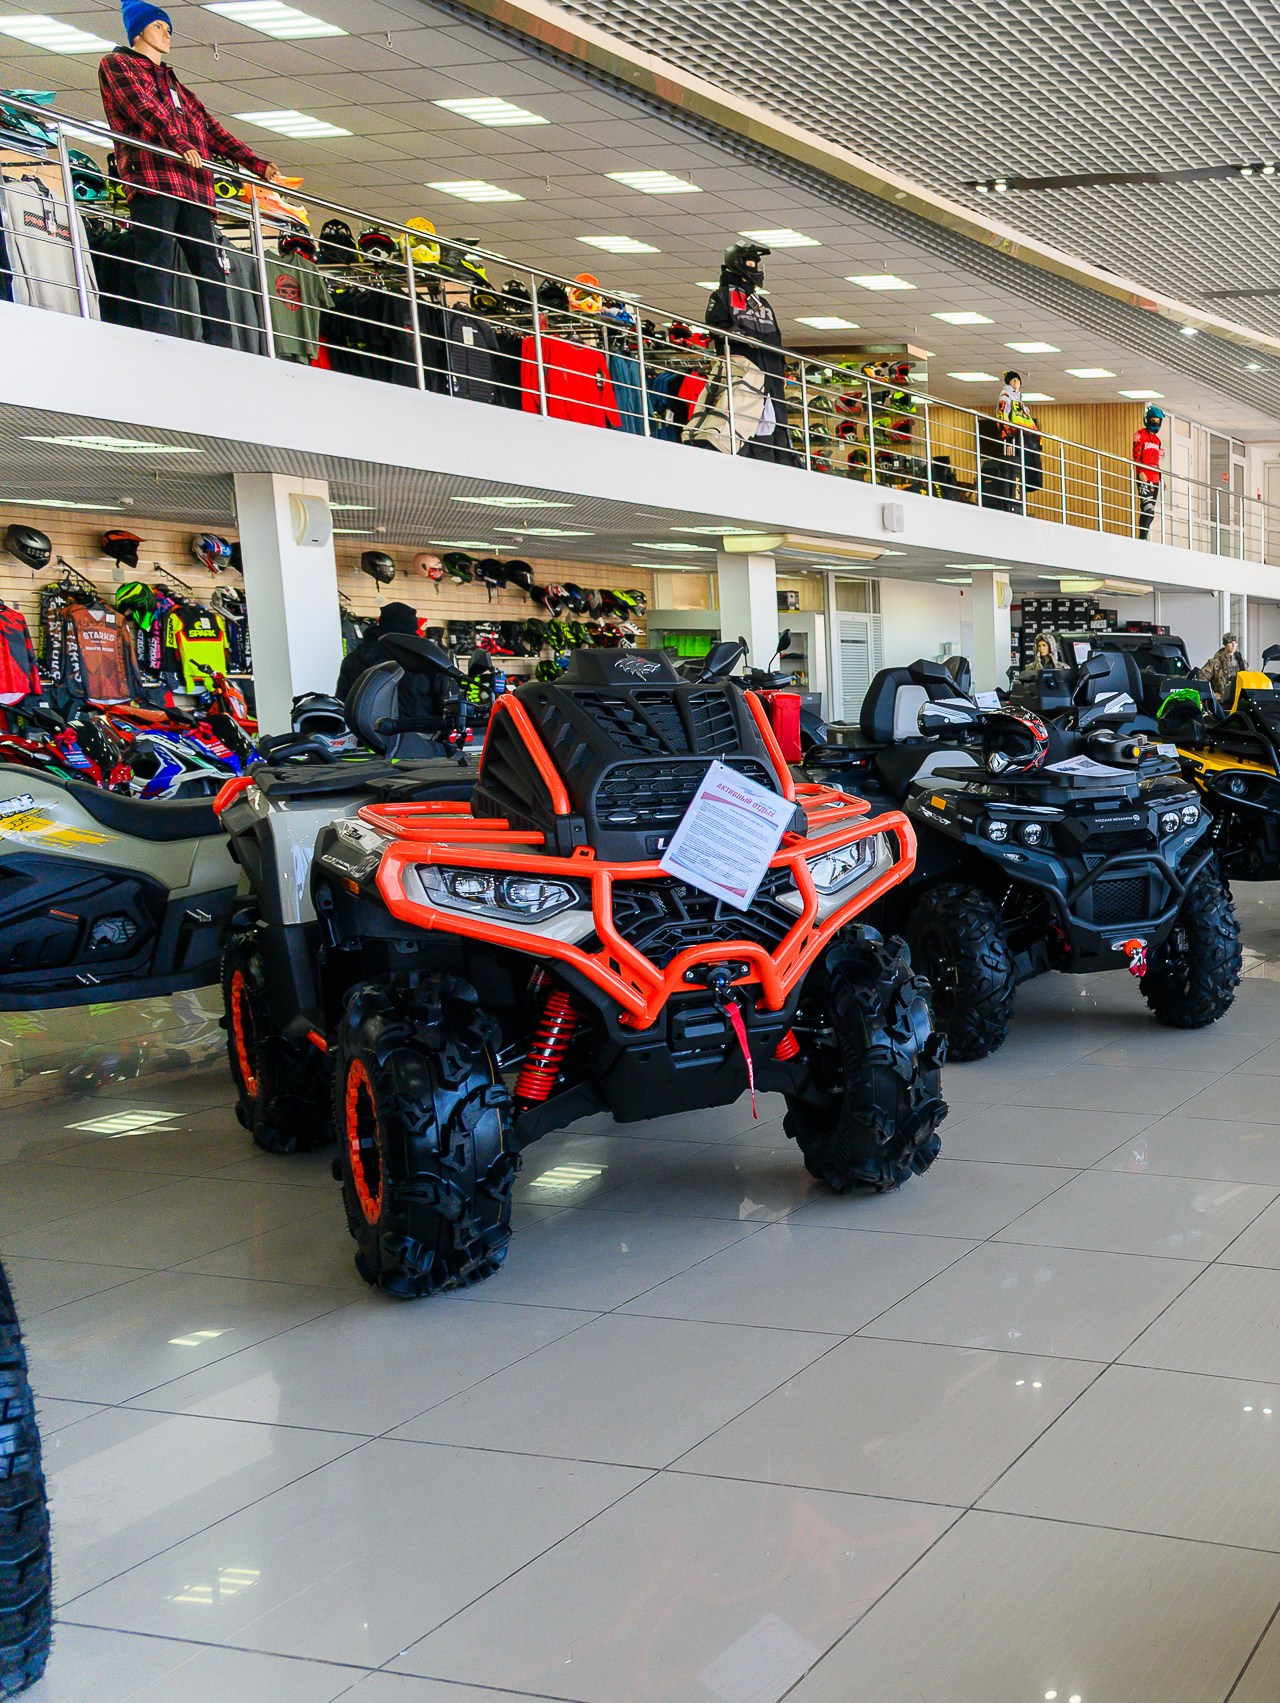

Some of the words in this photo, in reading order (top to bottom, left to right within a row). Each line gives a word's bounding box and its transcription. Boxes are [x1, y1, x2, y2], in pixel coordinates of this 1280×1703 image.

[82, 631, 116, 642] STARKS
[188, 629, 217, 638] SPARK
[716, 783, 753, 805] АКТИВНЫЙ
[752, 802, 776, 818] ОТДЫХ
